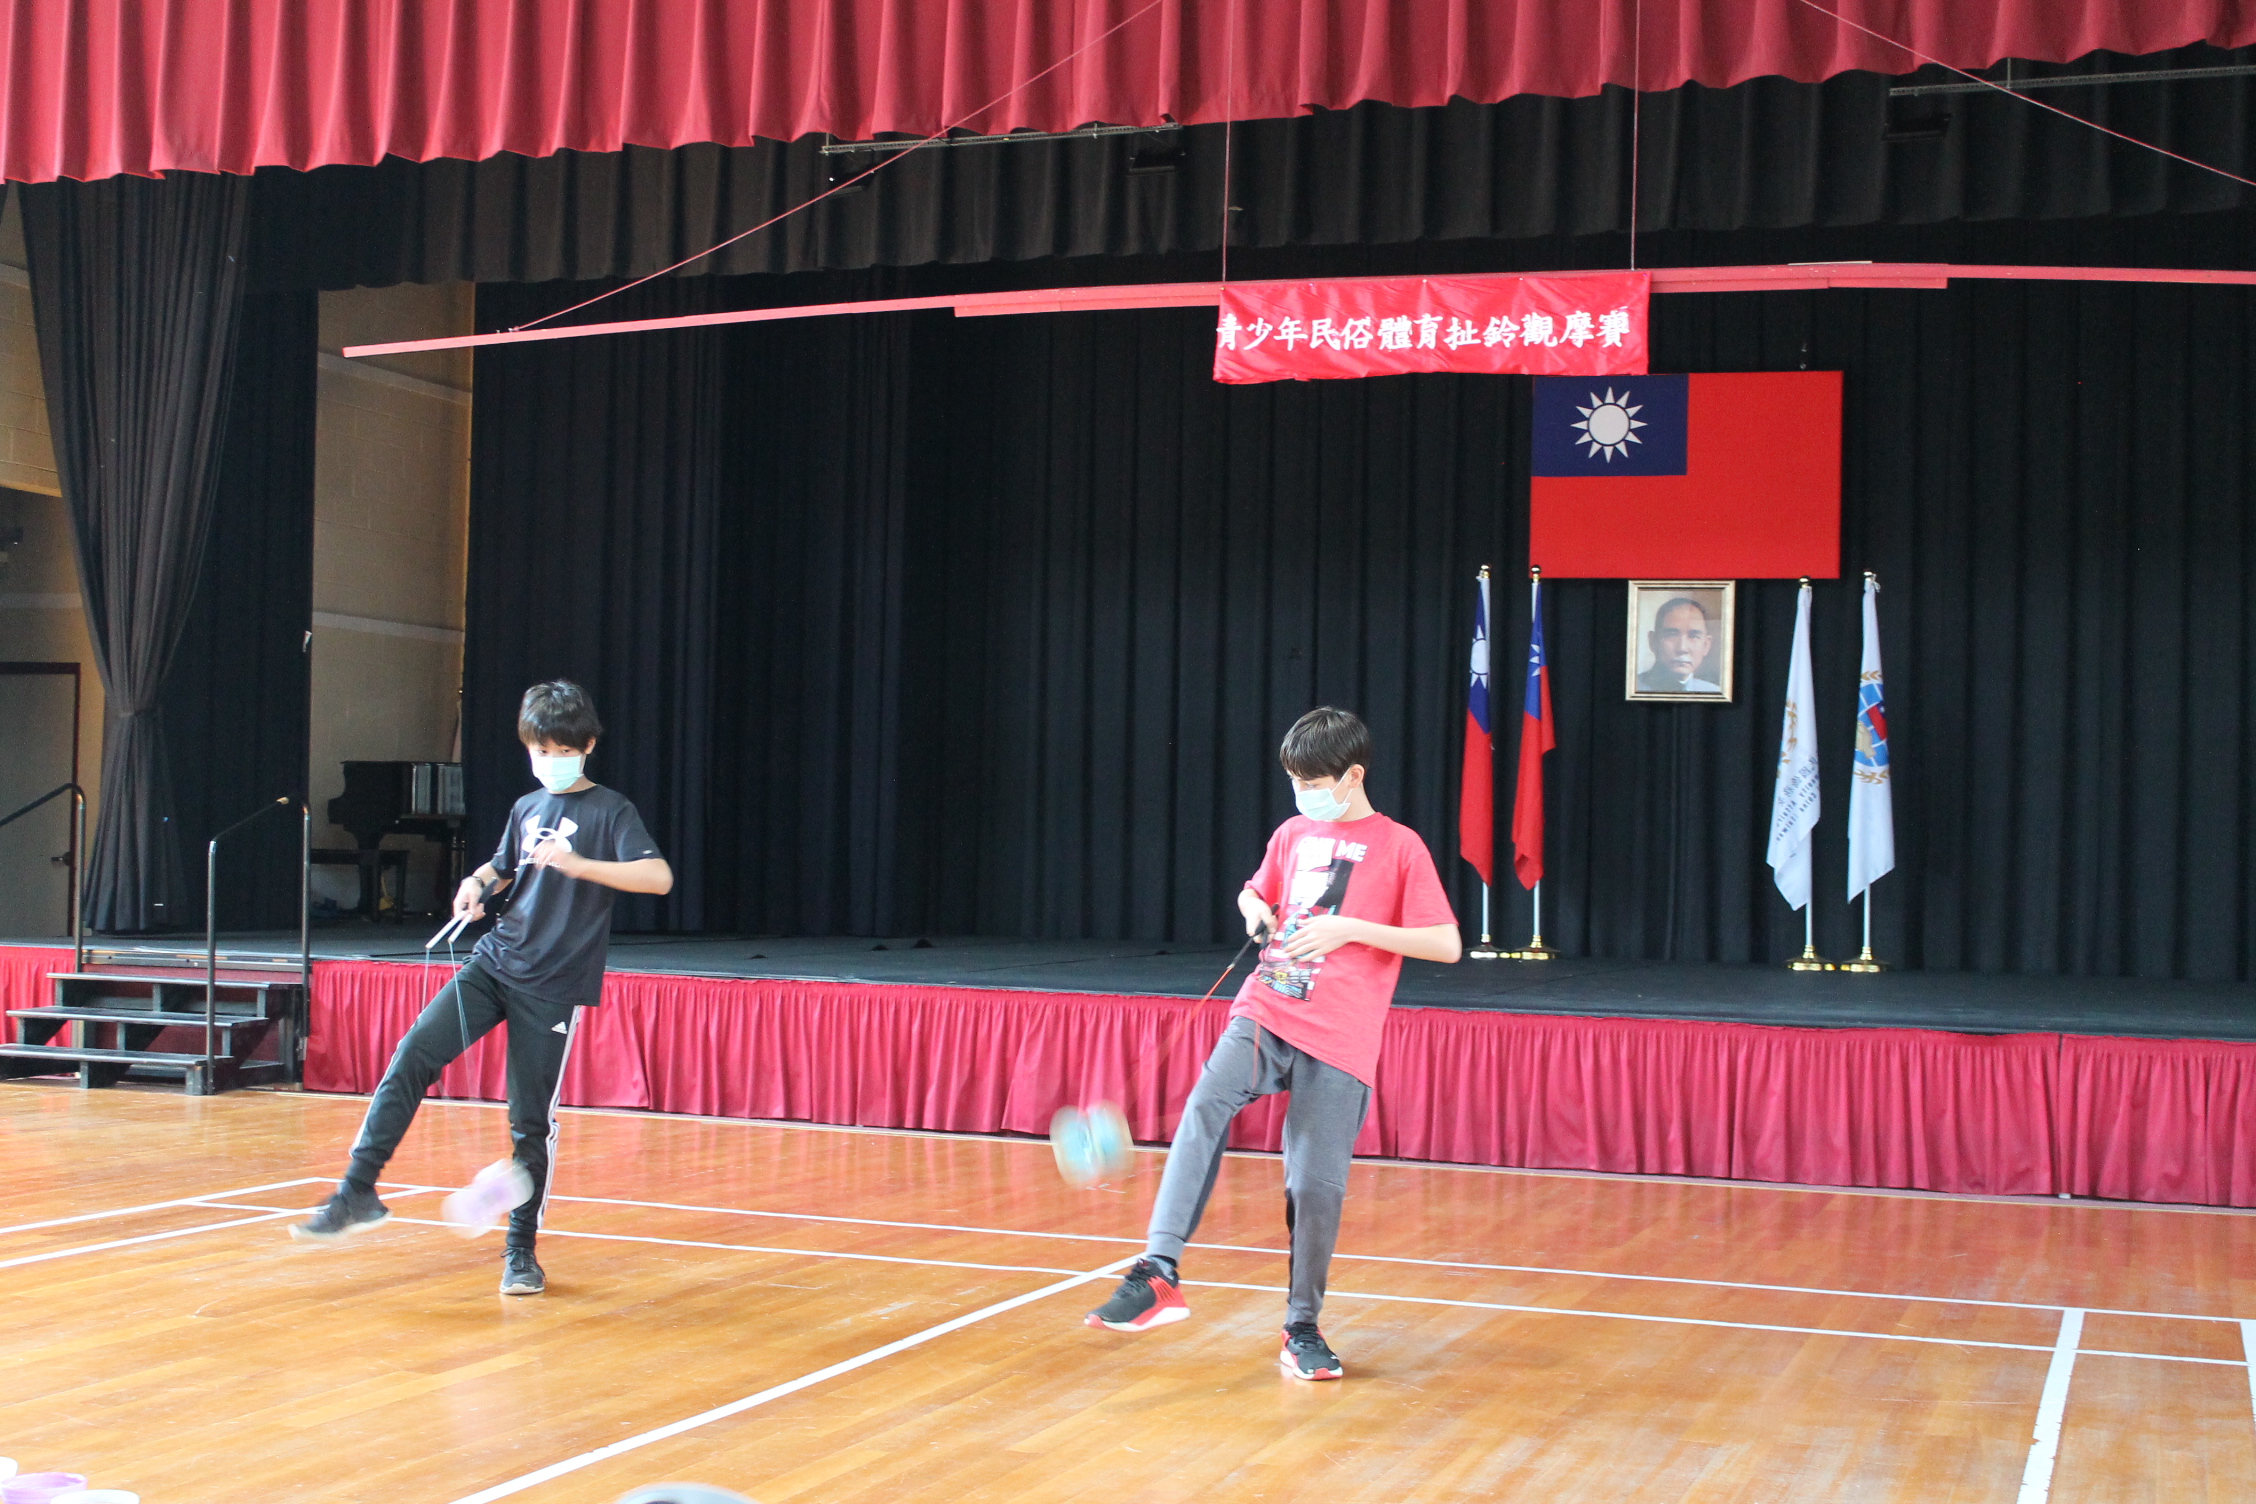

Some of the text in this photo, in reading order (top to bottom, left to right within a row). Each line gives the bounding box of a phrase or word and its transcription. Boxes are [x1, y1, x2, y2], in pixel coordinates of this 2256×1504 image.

[1215, 306, 1631, 351] 青少年民俗體育扯鈴觀摩賽
